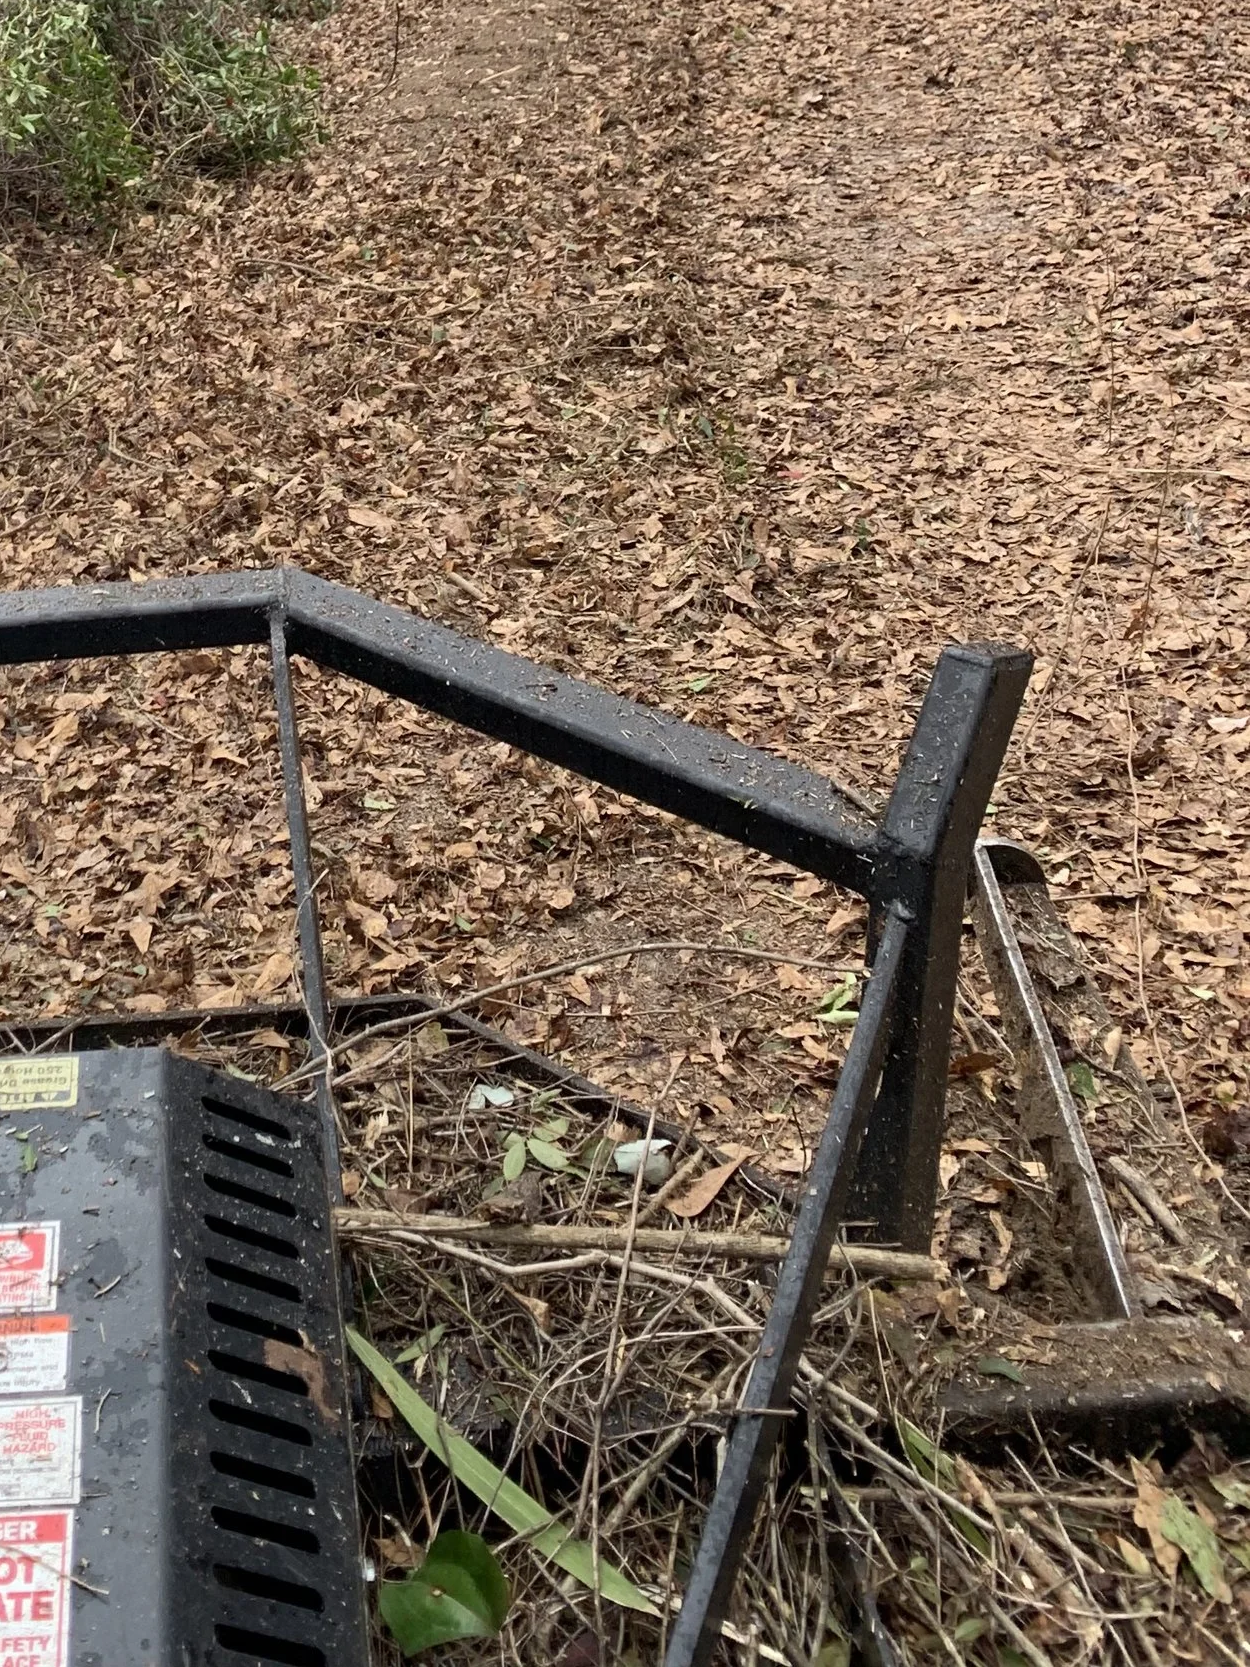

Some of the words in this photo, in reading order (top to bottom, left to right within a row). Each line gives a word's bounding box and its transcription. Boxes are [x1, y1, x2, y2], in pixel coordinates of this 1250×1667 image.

[38, 1066, 63, 1075] 250
[15, 1408, 51, 1418] HIGH
[3, 1442, 56, 1454] HAZARD
